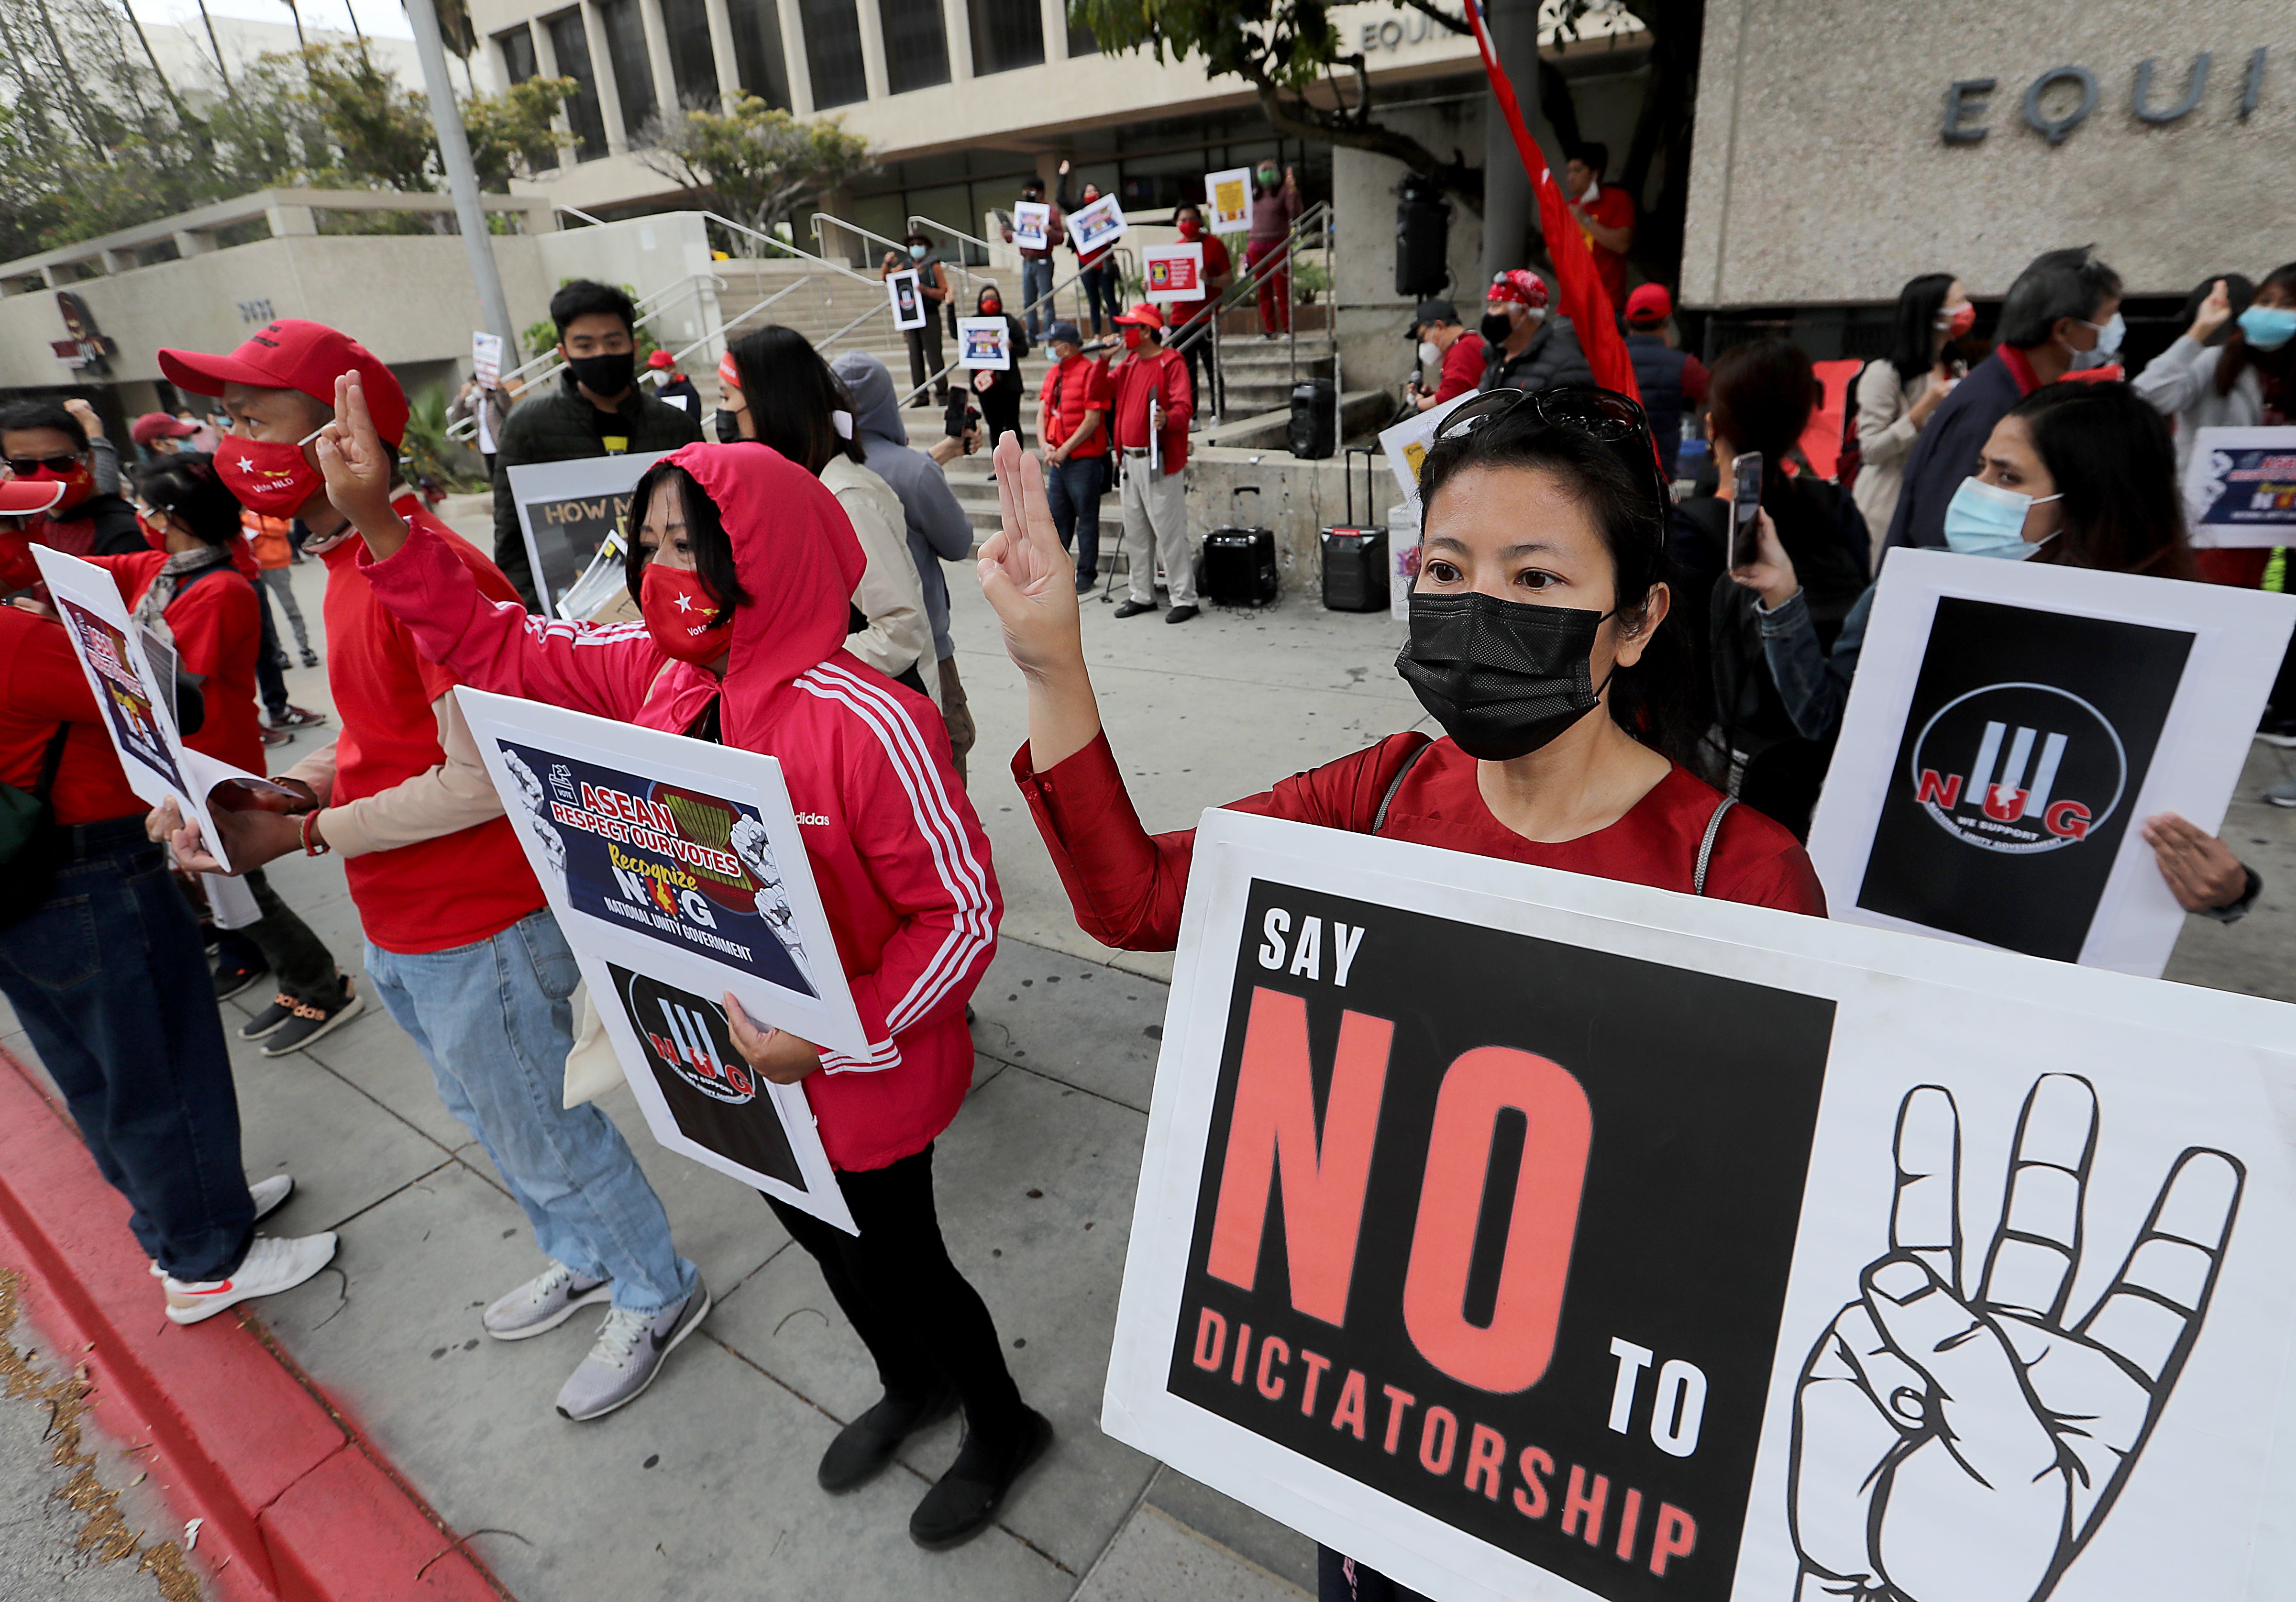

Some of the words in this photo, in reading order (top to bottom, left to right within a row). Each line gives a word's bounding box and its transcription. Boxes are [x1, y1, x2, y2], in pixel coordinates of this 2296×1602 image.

[1362, 13, 1446, 52] EQUI
[1941, 45, 2268, 146] EQUI
[252, 484, 273, 493] Vote
[271, 477, 294, 489] NLD
[544, 498, 607, 525] HOW
[686, 624, 707, 636] Vote
[557, 788, 574, 800] VOTE
[581, 781, 679, 837] ASEAN
[550, 800, 630, 844] RESPECT
[630, 825, 675, 858] OUR
[670, 837, 741, 878] VOTES
[795, 812, 830, 826] didas
[1957, 816, 1978, 828] WE
[1978, 820, 2040, 841] SUPPORT
[608, 842, 698, 891] Recognize
[604, 896, 653, 927] NATIONAL
[651, 913, 682, 937] UNITY
[682, 924, 753, 962] GOVERNMENT
[1258, 906, 1365, 988] SAY
[700, 1076, 734, 1095] SUPPORT
[1205, 984, 1596, 1397] NO
[1607, 1336, 1707, 1458] TO
[1192, 1306, 1699, 1578] DICTATORSHIP
